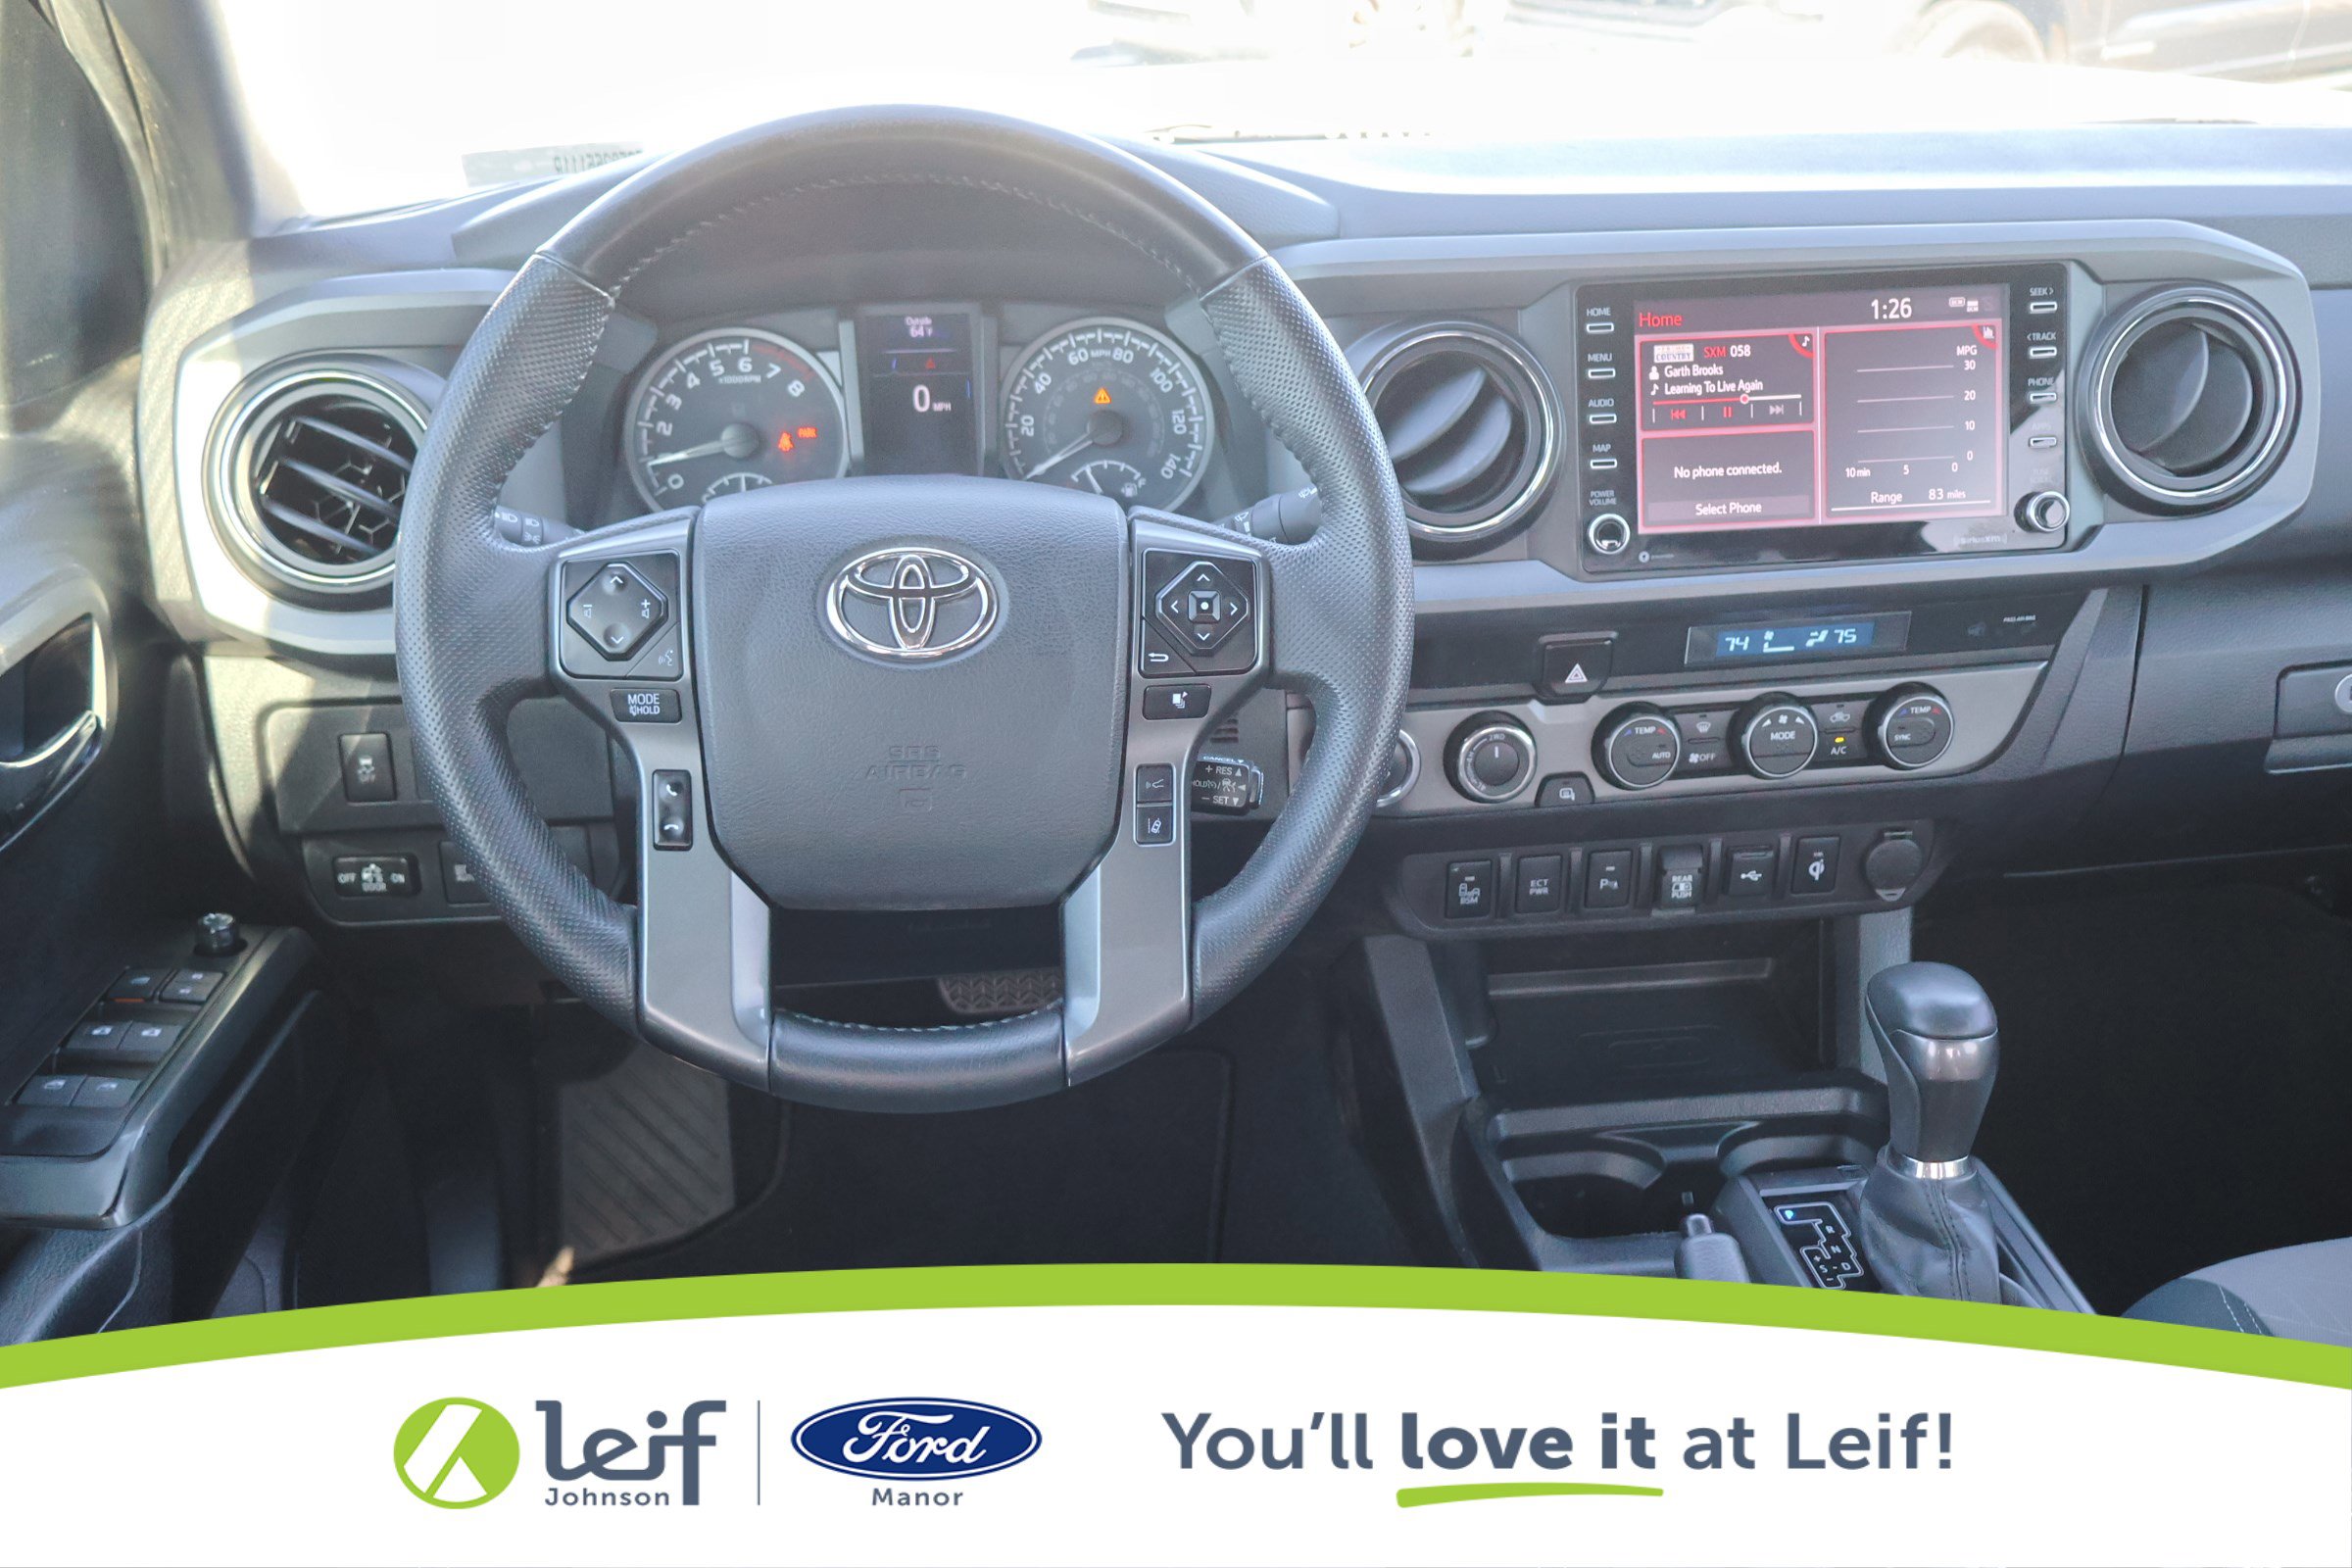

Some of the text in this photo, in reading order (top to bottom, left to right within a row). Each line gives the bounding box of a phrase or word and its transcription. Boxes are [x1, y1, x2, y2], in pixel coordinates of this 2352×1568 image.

[1586, 307, 1611, 317] HOME
[1871, 298, 1912, 319] 1:26
[1639, 313, 1683, 327] Home
[2032, 331, 2057, 341] TRACK
[1112, 347, 1134, 364] 80
[1703, 345, 1751, 359] SXM 058
[1956, 345, 1978, 356] MPG
[1067, 348, 1090, 366] 60
[1588, 353, 1612, 363] MENU
[1656, 353, 1692, 362] COUNTRY
[708, 359, 725, 376] 5
[738, 357, 753, 372] 6
[1963, 360, 1976, 370] 30
[765, 363, 782, 378] 7
[1664, 365, 1724, 377] Garth Brooks
[686, 372, 701, 389] 4
[1034, 372, 1052, 395] 40
[1149, 368, 1174, 393] 100
[787, 379, 806, 397] 8
[1664, 379, 1764, 396] Learning To Live Again
[912, 384, 931, 413] 0
[1964, 390, 1976, 401] 20
[665, 394, 683, 411] 3
[1588, 398, 1614, 408] AUDIO
[1020, 415, 1035, 437] 20
[1171, 409, 1188, 435] 120
[1965, 420, 1976, 431] 10
[656, 421, 673, 436] 2
[1592, 443, 1612, 453] MAP
[1966, 451, 1974, 461] 0
[1160, 454, 1182, 479] 140
[1674, 462, 1782, 480] No phone connected.
[1845, 466, 1871, 478] 10 min
[1903, 465, 1910, 475] 5
[1951, 463, 1958, 472] 0
[1871, 488, 1966, 505] Range 83 miles
[1589, 498, 1617, 507] VOLUME
[1695, 502, 1762, 516] Select Phone
[1834, 628, 1857, 644] 75
[1725, 636, 1749, 652] 74
[627, 693, 661, 705] MODE
[637, 706, 661, 715] HOLD
[1910, 706, 1932, 714] TEMP
[1635, 725, 1656, 735] TEMP
[1770, 730, 1795, 741] MODE
[1651, 751, 1671, 760] AUTO
[1830, 746, 1847, 756] A/C
[1202, 755, 1236, 763] CANCEL
[1699, 753, 1716, 761] OFF
[1215, 766, 1233, 776] RES
[1212, 796, 1229, 805] SET
[1530, 878, 1549, 887] ECT
[1672, 874, 1693, 883] REAR
[1529, 887, 1548, 896] PWR
[1825, 1225, 1836, 1234] R
[1830, 1245, 1841, 1253] N
[1819, 1264, 1829, 1273] S
[1840, 1262, 1851, 1271] D
